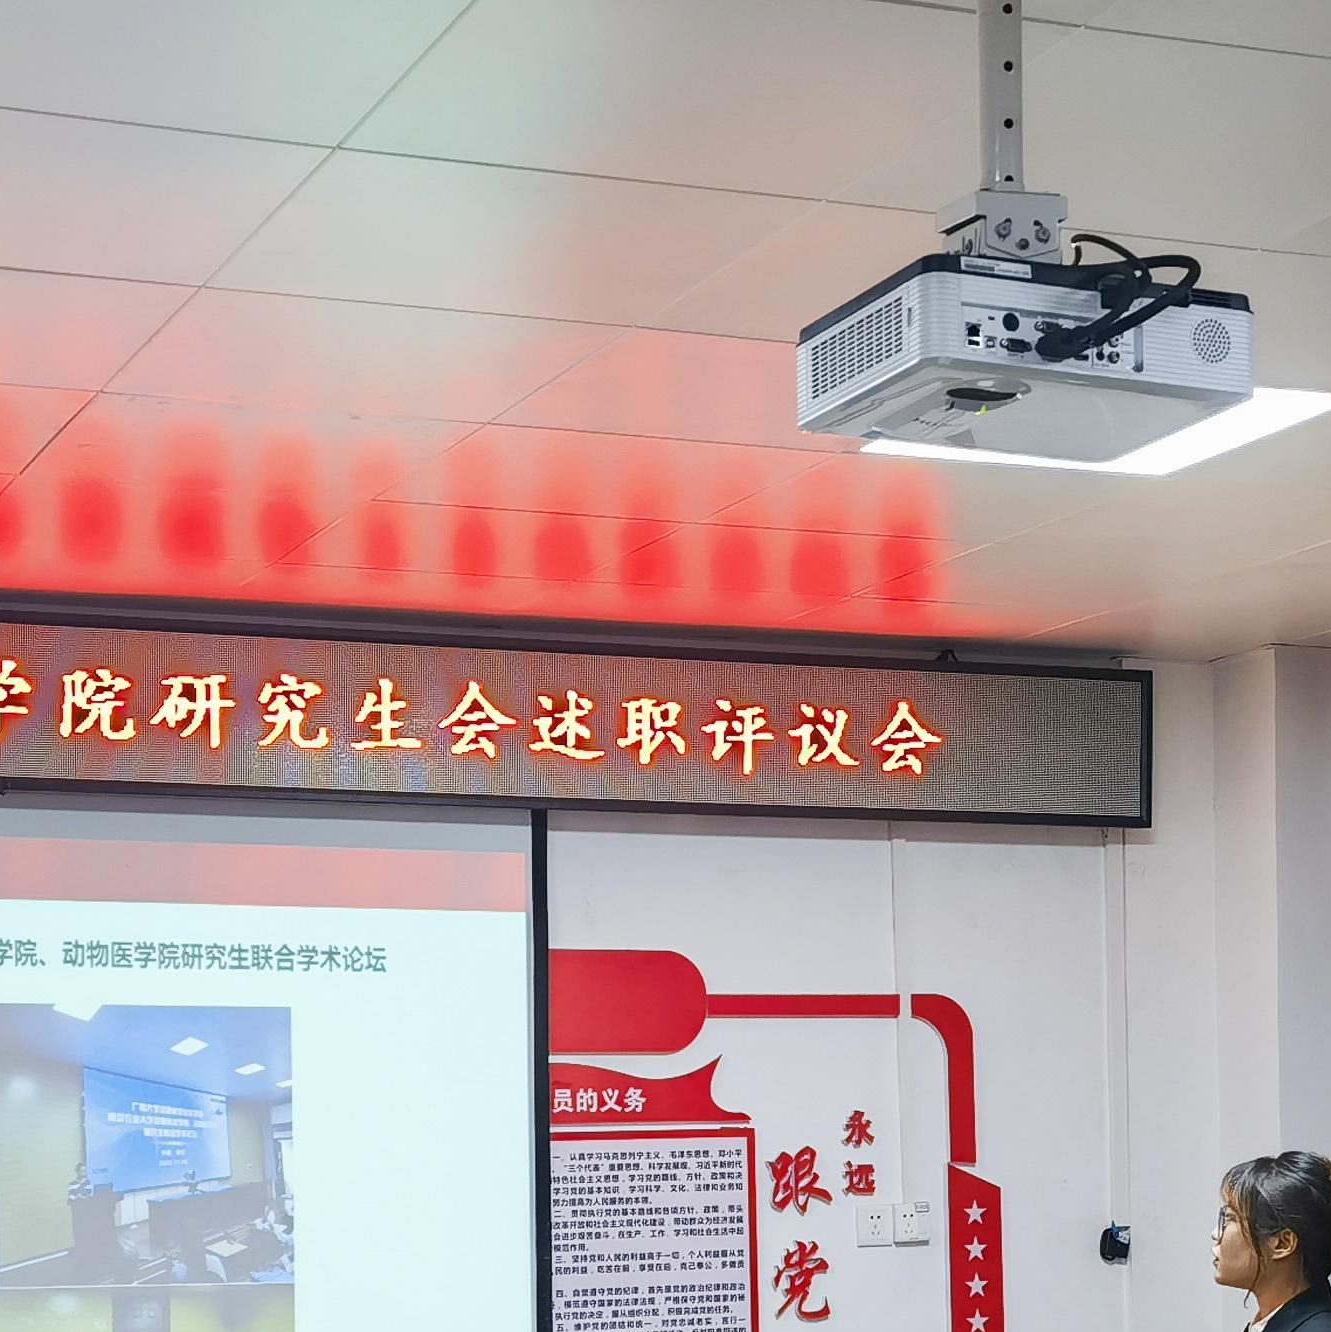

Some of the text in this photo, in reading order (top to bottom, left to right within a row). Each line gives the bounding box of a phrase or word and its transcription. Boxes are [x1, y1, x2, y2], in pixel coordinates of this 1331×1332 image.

[552, 1087, 647, 1114] 员的义务
[843, 1110, 876, 1197] 永远
